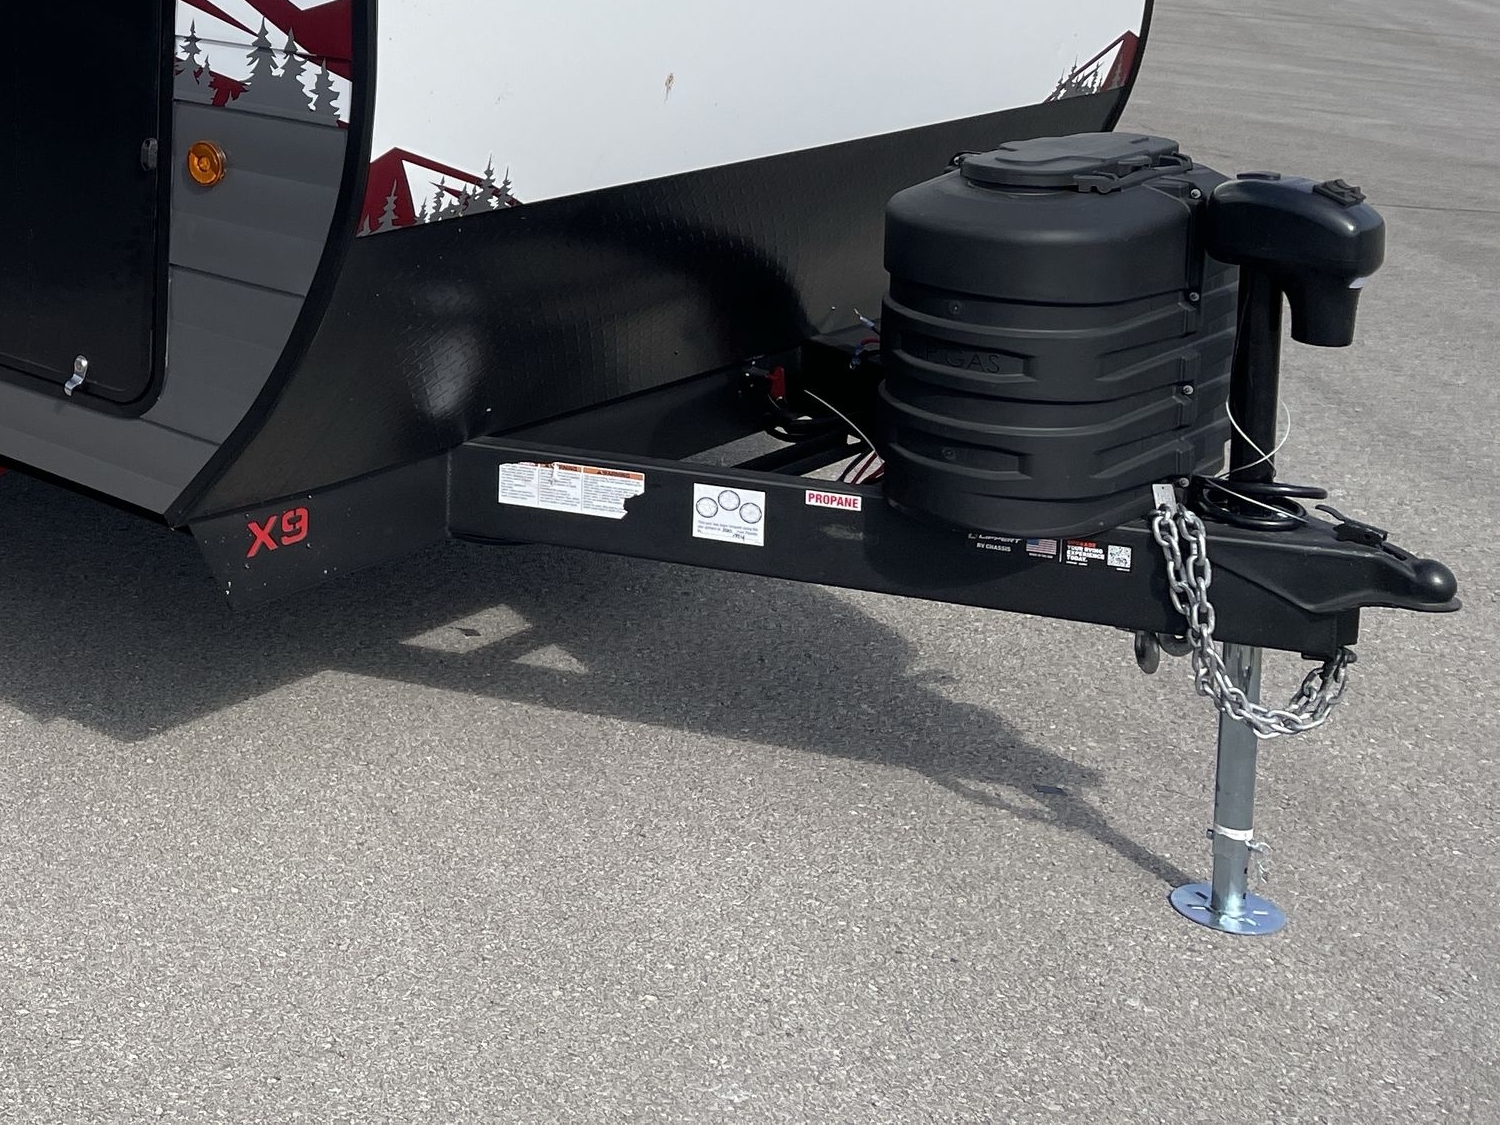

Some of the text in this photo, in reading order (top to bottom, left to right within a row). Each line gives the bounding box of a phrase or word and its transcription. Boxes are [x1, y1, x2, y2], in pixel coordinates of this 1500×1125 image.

[945, 347, 1001, 374] GAS
[807, 492, 859, 509] PROPANE
[245, 506, 310, 559] X9
[976, 542, 1012, 553] RV CHASSIS
[1067, 545, 1084, 553] YOUR
[1066, 550, 1105, 561] EXPERIENCE
[1066, 555, 1088, 563] TODAY.
